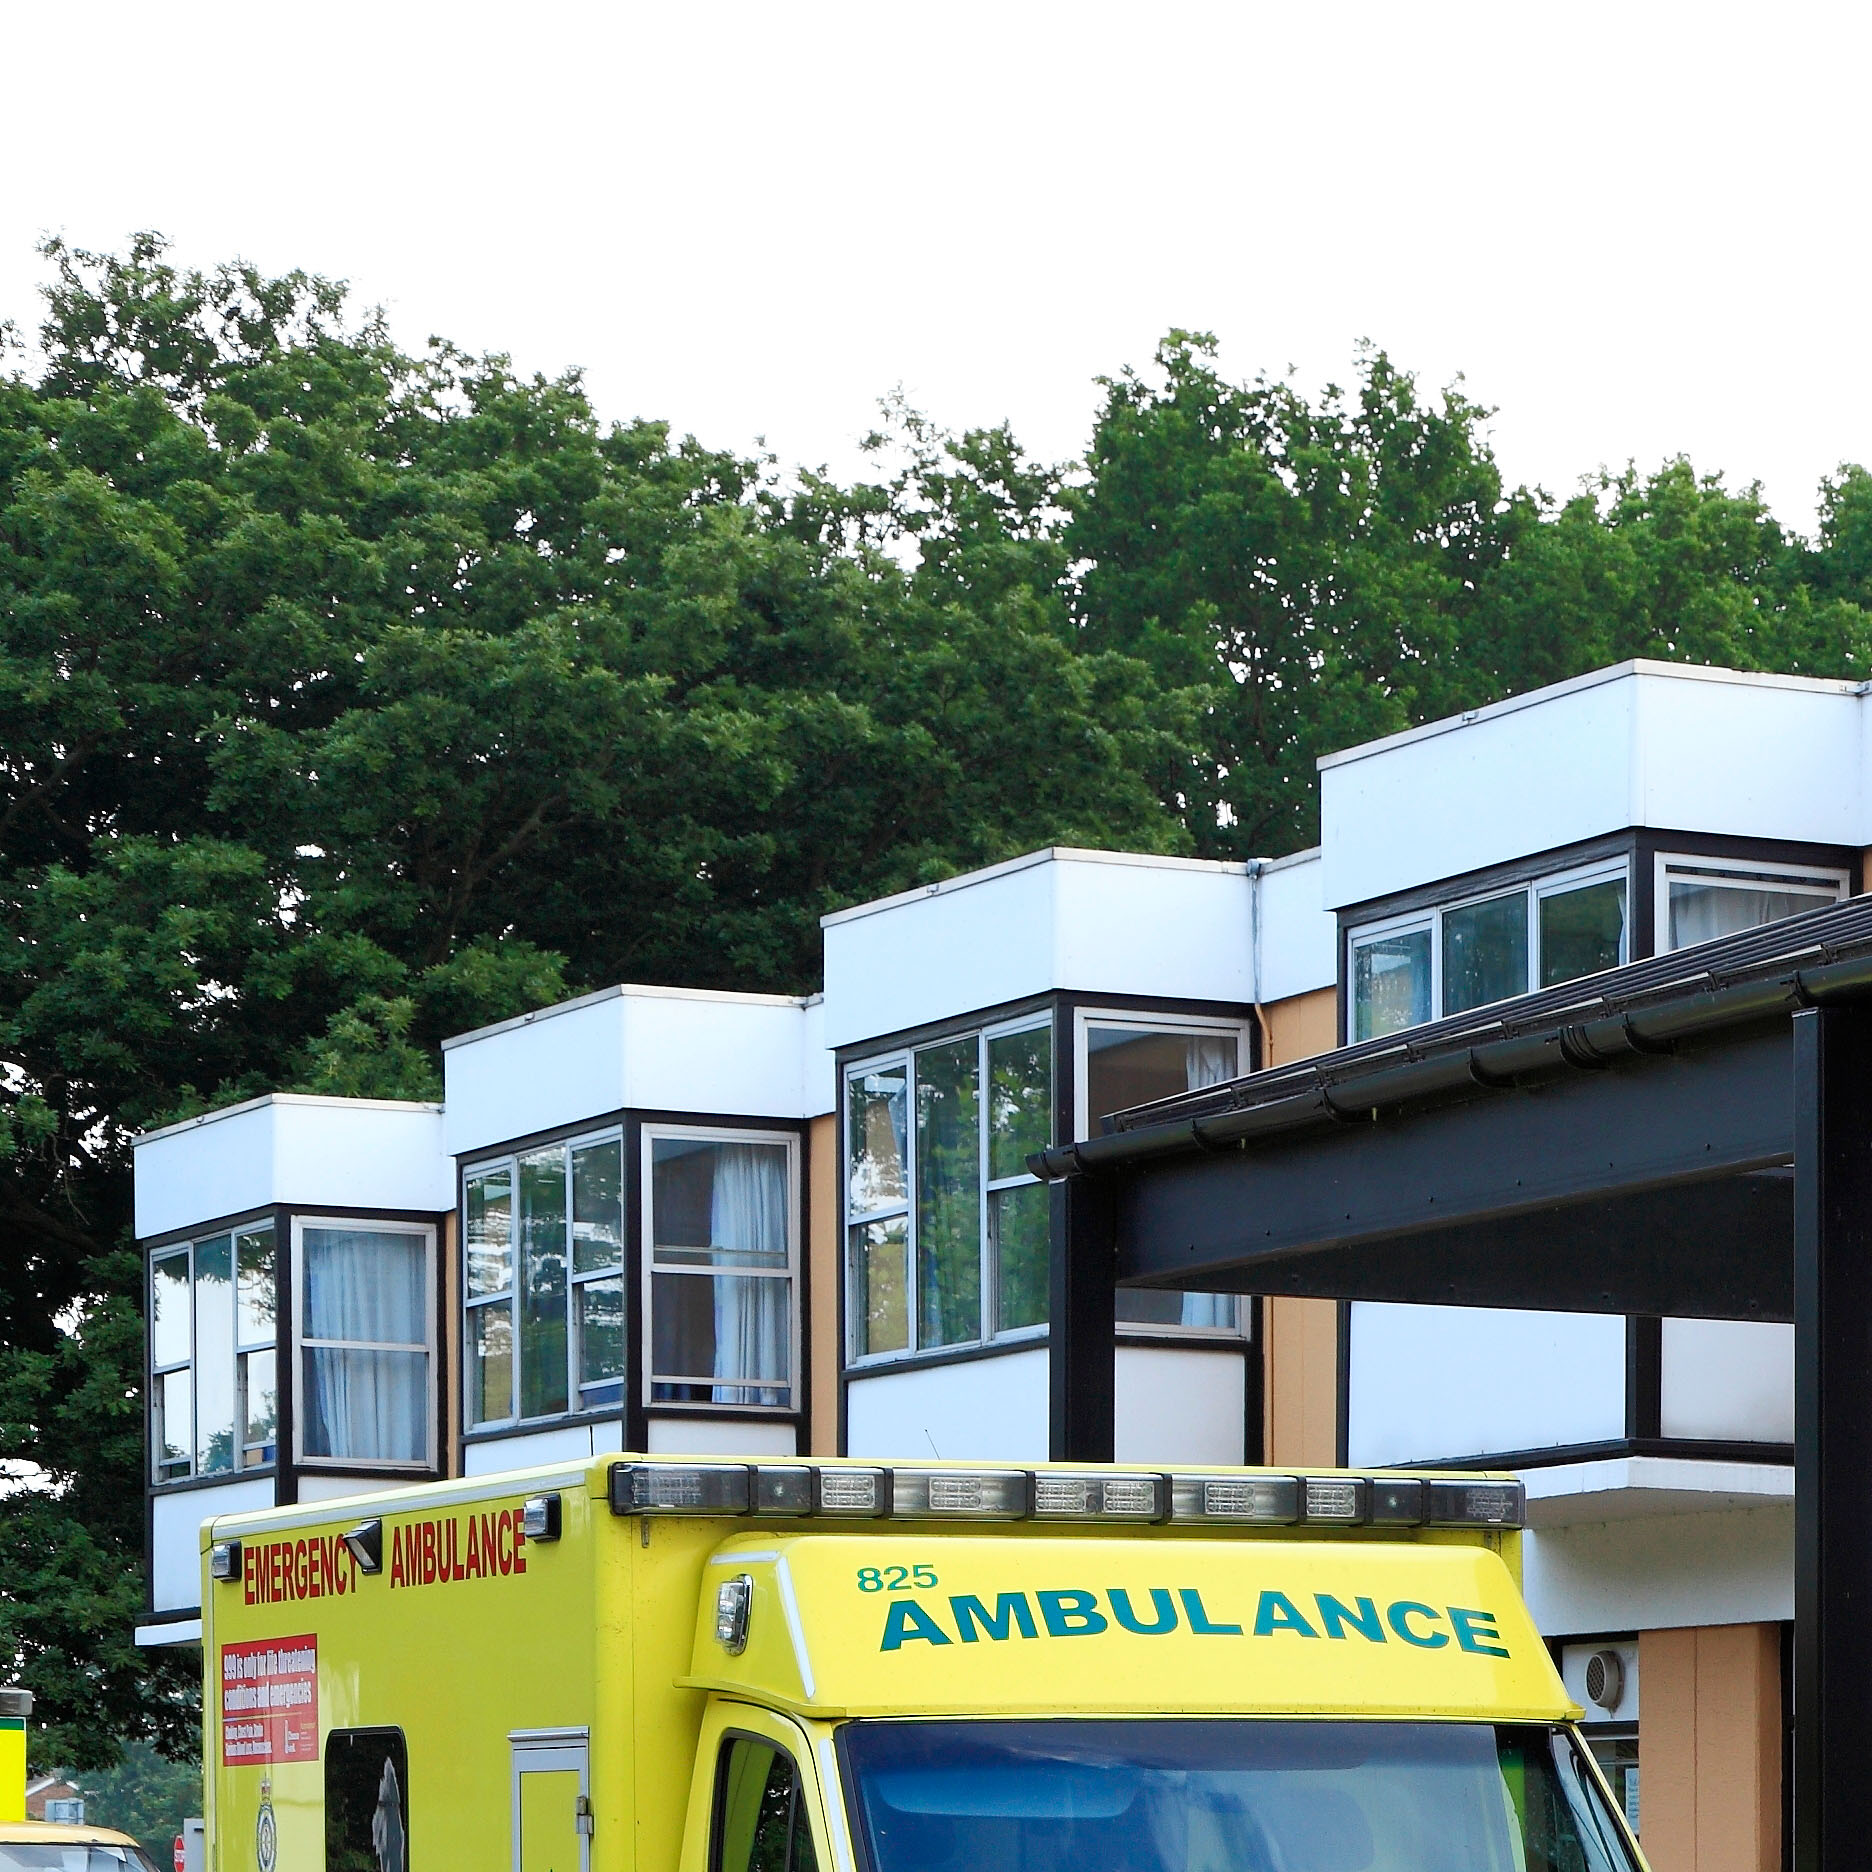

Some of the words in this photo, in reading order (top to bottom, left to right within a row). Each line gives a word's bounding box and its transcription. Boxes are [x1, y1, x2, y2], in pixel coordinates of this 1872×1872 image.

[244, 1533, 357, 1605] EMERGENCY
[390, 1509, 527, 1588] AMBULANCE
[856, 1563, 939, 1593] 825
[879, 1587, 1512, 1660] AMBULANCE
